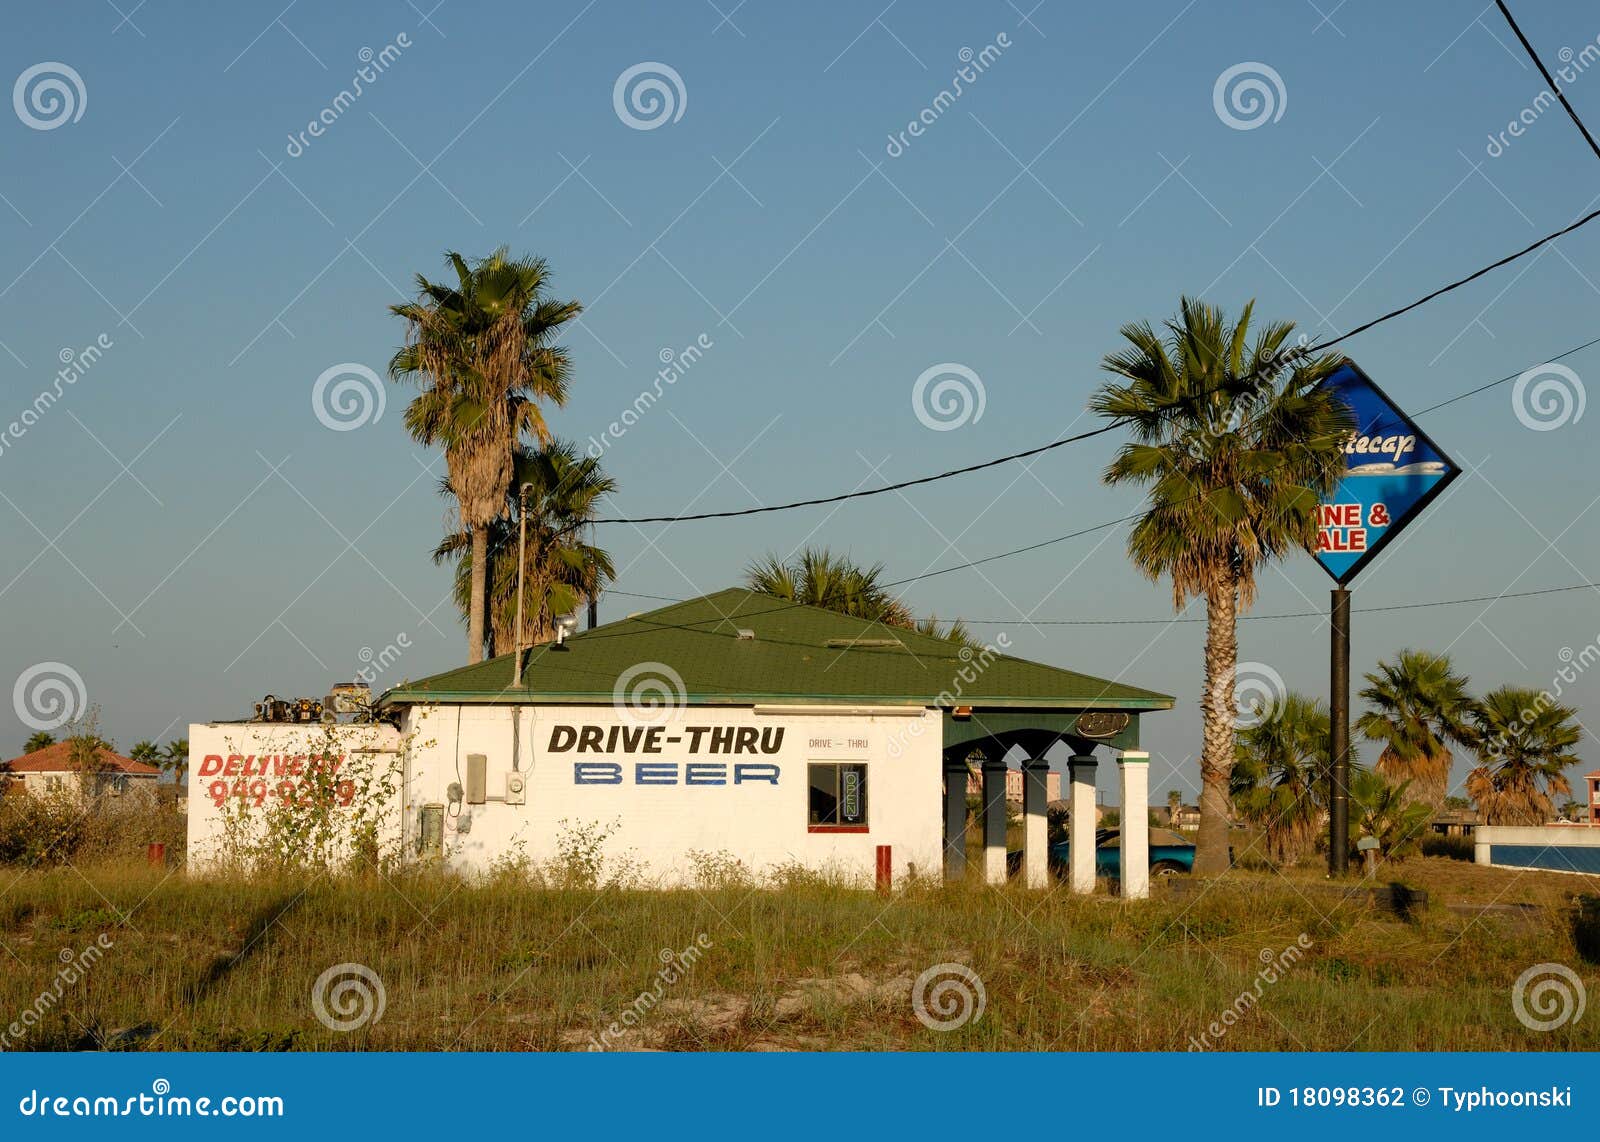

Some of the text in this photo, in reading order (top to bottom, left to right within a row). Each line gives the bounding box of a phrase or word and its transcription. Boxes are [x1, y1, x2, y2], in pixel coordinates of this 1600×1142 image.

[1316, 503, 1391, 528] INE &
[547, 725, 785, 754] DRIVE-THRU
[809, 739, 832, 748] DRIVE
[848, 739, 868, 748] THRU
[574, 762, 781, 785] BEER
[846, 774, 856, 815] OPEN
